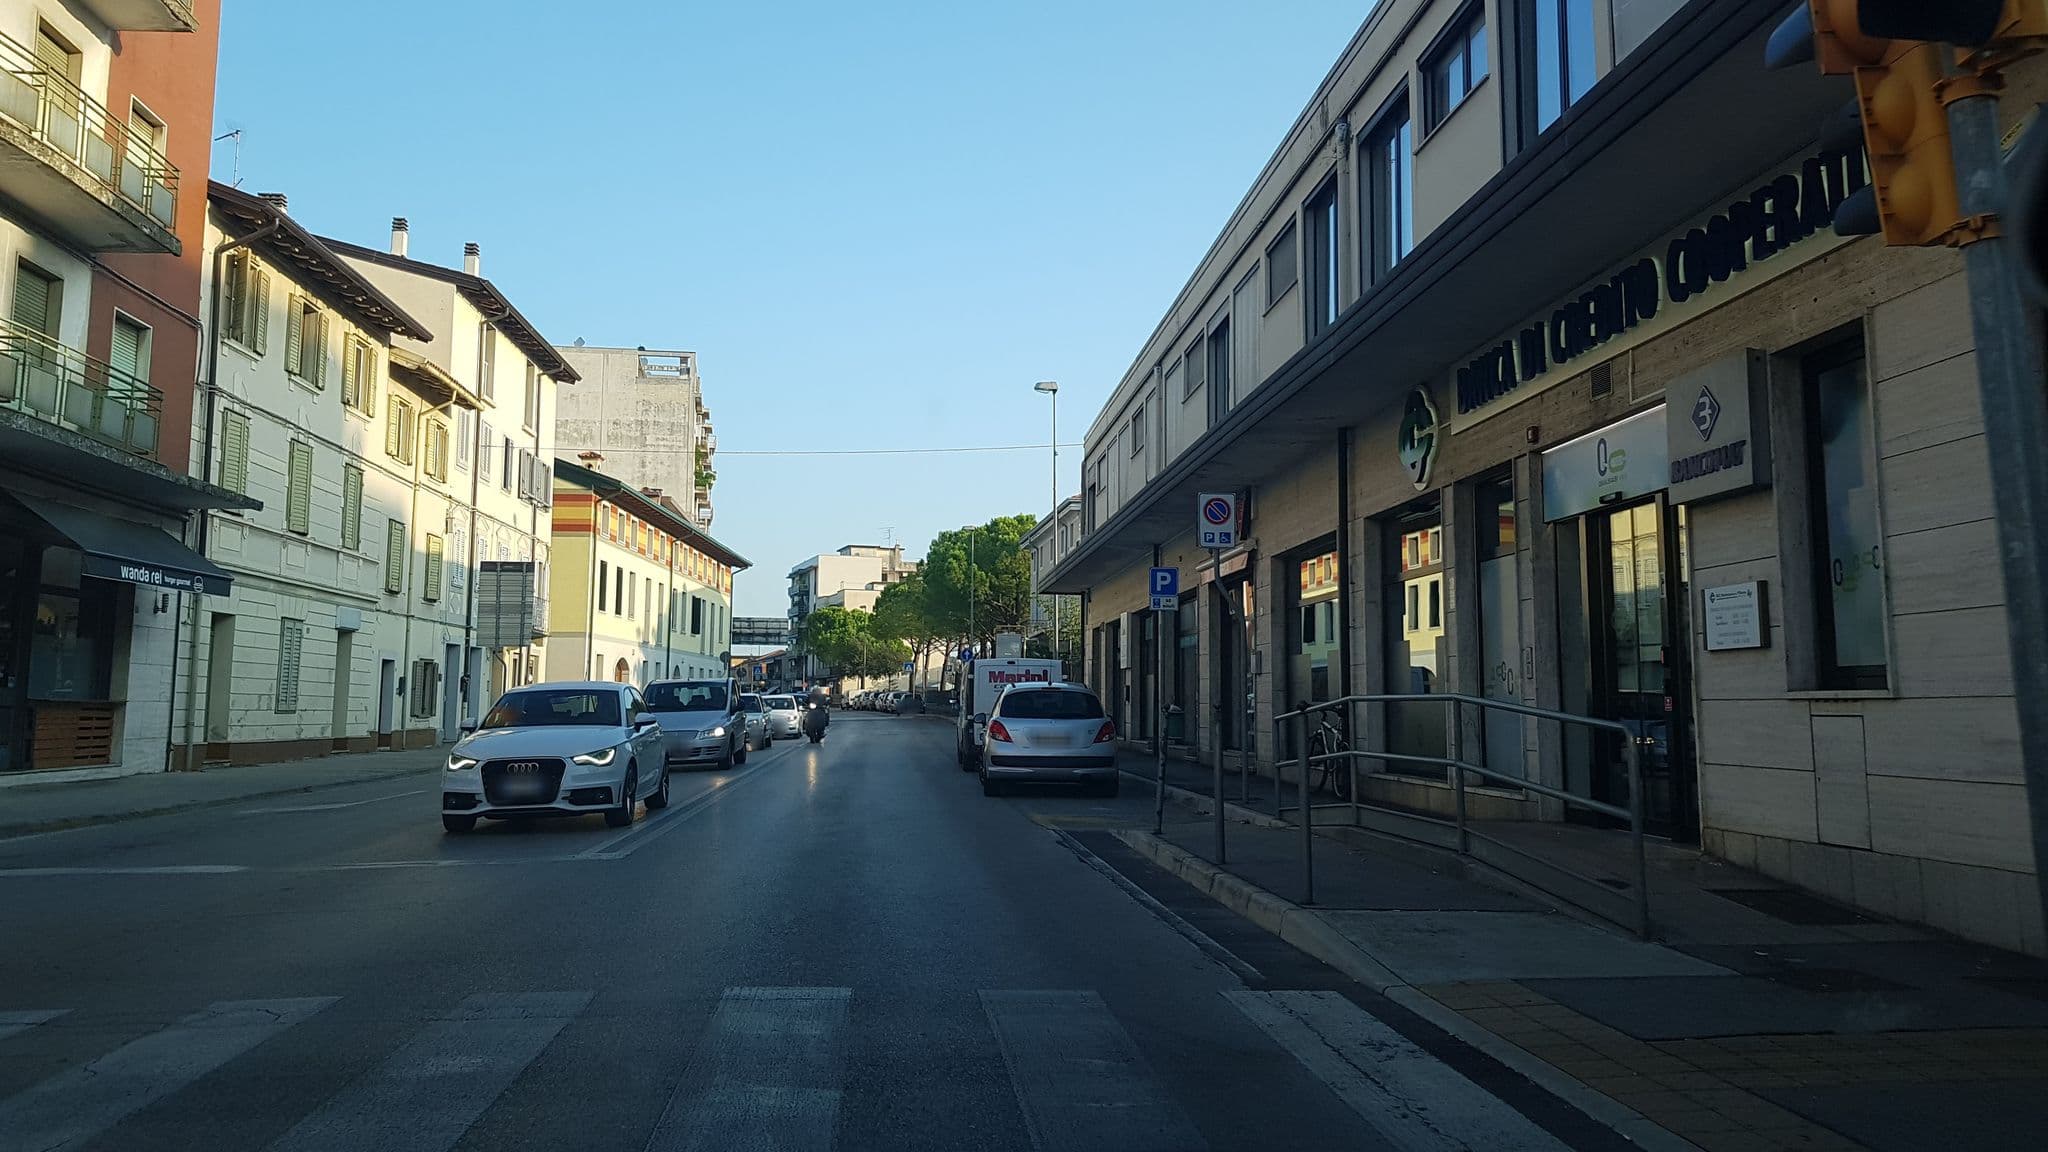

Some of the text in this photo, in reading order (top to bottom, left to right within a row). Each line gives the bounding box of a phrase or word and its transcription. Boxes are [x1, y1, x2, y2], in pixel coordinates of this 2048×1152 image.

[1456, 142, 1869, 415] BANCA DI CREDITO COOPERATI
[1670, 439, 1747, 485] BANCOMAT
[1206, 533, 1213, 541] P
[120, 565, 162, 585] wanda rei
[1156, 572, 1172, 591] P
[989, 669, 1048, 683] Marini
